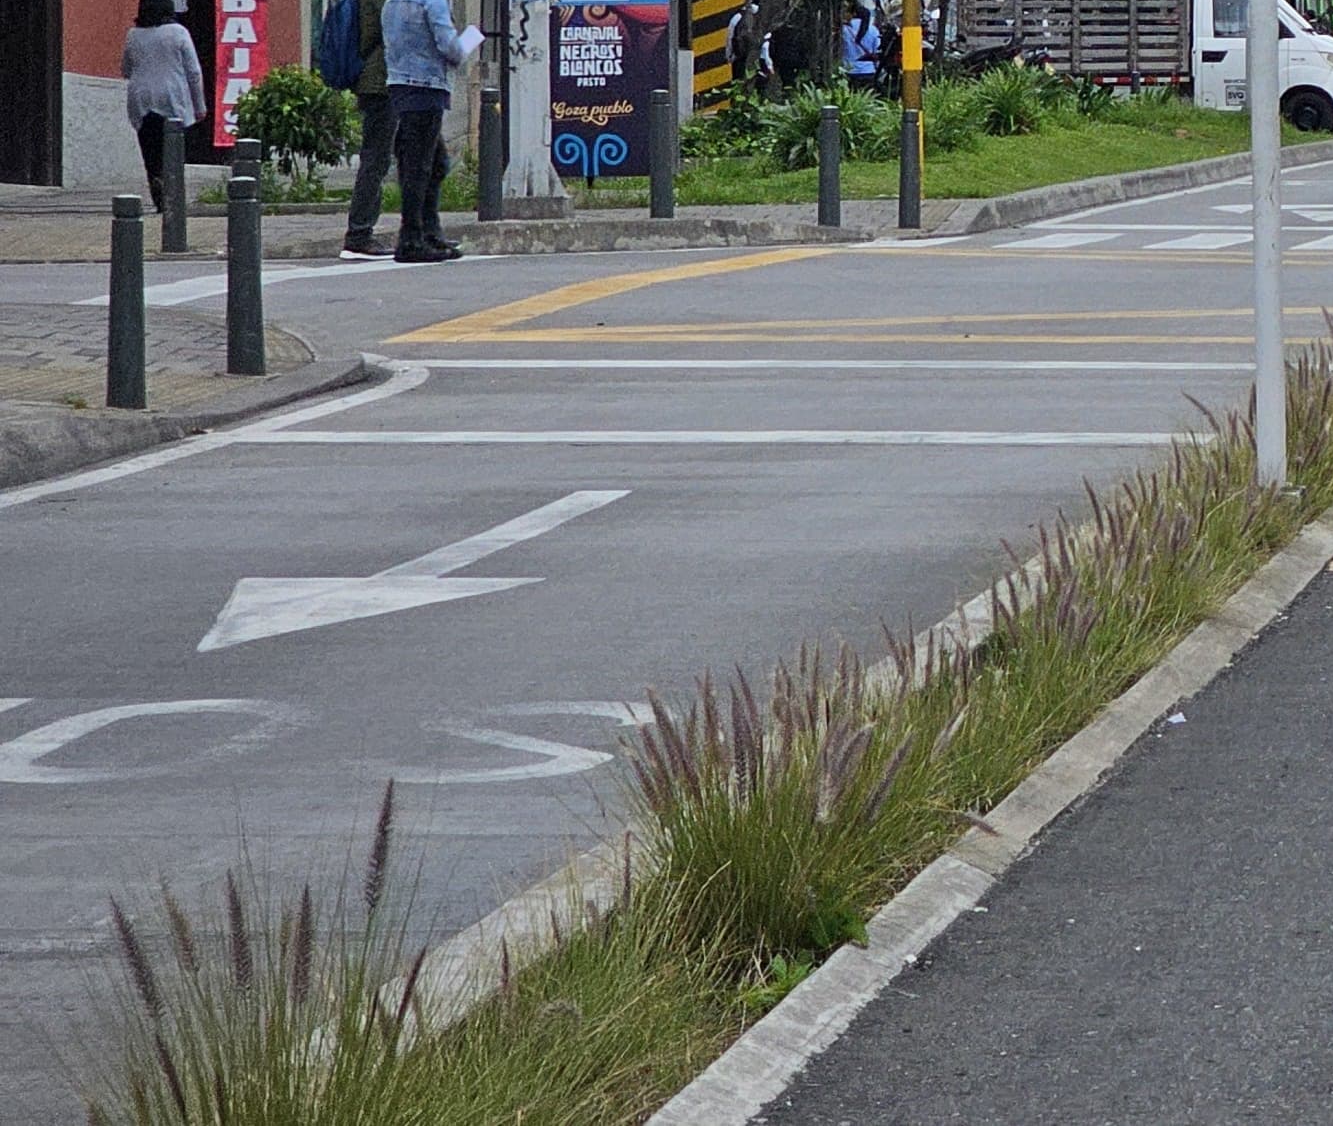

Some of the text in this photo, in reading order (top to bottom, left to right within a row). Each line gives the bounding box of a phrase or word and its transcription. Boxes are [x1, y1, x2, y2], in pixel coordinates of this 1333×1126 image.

[560, 45, 615, 60] NEGROS
[560, 60, 624, 76] BLANCOS
[577, 77, 606, 87] PASTO
[552, 99, 634, 126] Goza pueblo
